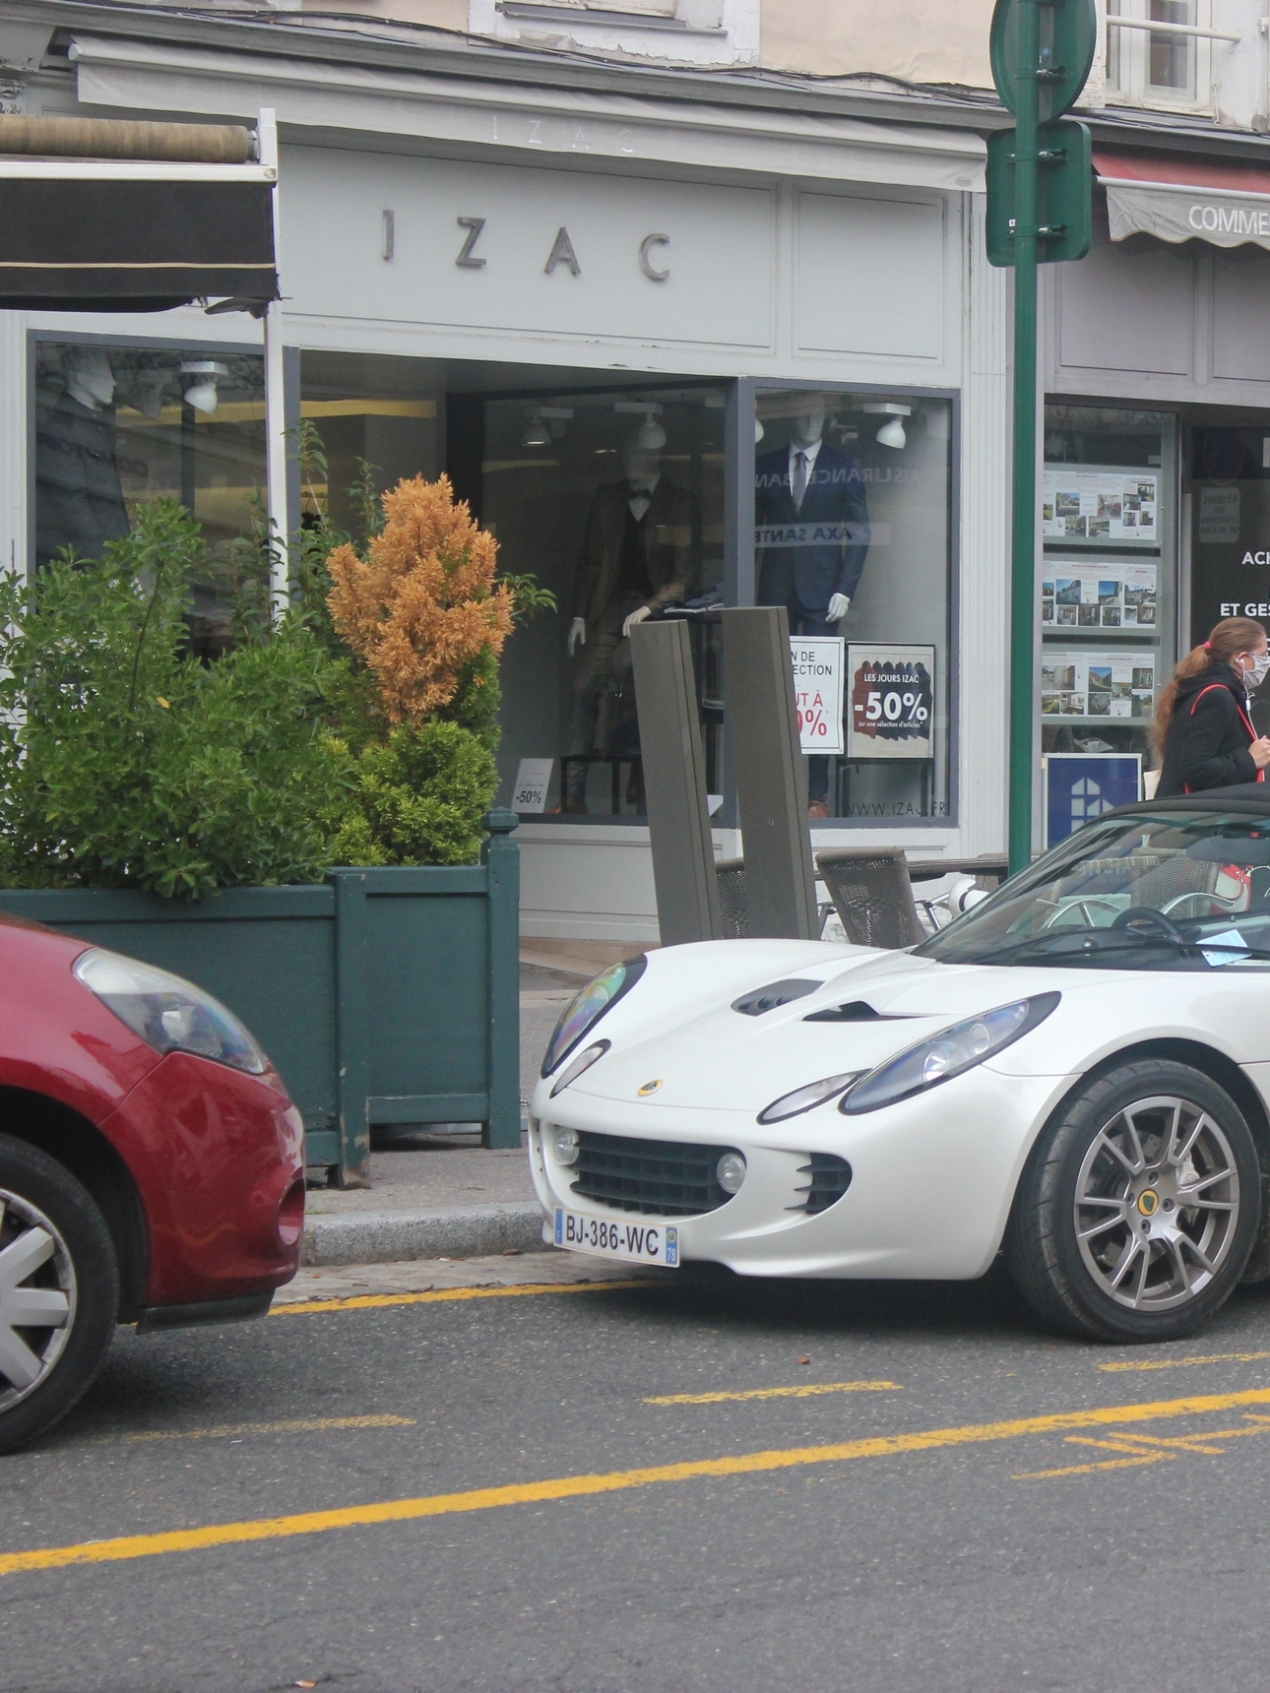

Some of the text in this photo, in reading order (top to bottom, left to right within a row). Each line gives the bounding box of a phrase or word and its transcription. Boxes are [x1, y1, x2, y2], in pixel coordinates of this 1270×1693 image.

[381, 208, 671, 283] IZAC
[1220, 603, 1241, 617] ET
[800, 651, 815, 662] DE
[864, 673, 919, 684] LES JOURS IZAC
[813, 689, 823, 707] À
[854, 691, 928, 721] -50%
[516, 790, 542, 804] -50%
[566, 1215, 659, 1256] BJ-386-WC
[666, 1247, 676, 1262] 78
